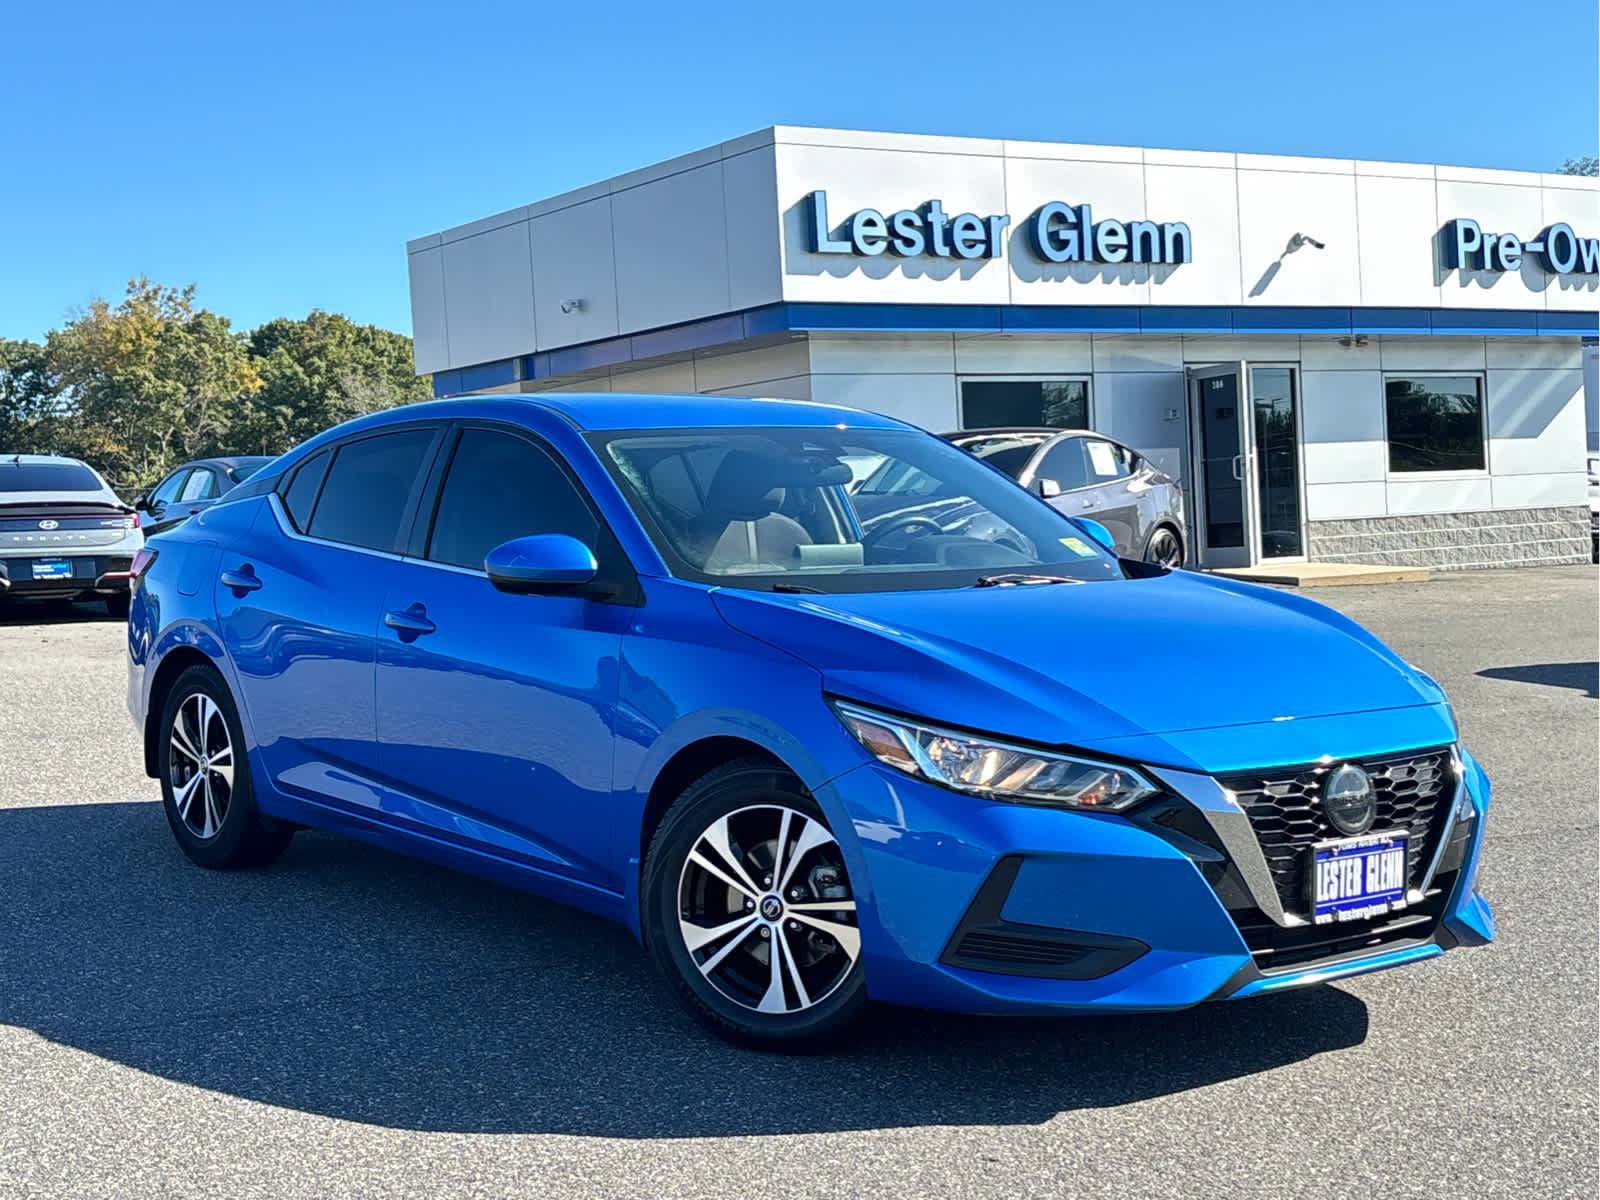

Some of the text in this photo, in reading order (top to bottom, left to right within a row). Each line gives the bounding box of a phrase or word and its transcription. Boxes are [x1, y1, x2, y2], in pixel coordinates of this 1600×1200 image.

[811, 189, 1192, 264] Lester Glenn
[1316, 850, 1404, 903] LESTER GLENN
